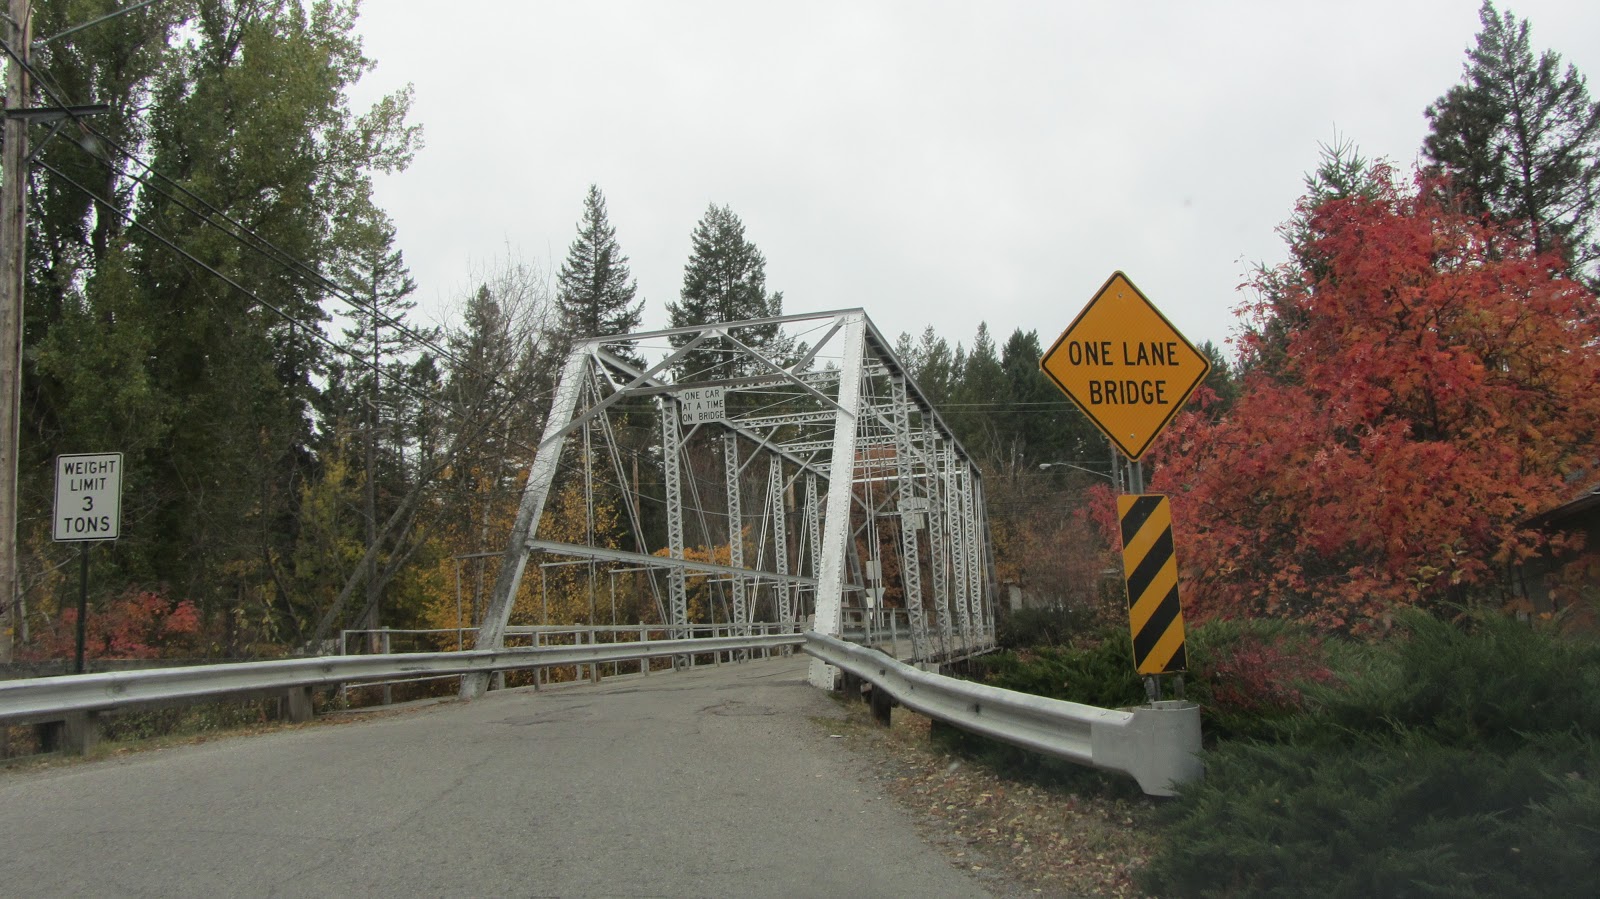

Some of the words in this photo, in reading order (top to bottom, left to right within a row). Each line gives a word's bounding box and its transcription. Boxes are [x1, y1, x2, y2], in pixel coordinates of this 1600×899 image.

[1069, 340, 1114, 366] ONE
[1122, 341, 1180, 366] LANE
[685, 391, 700, 400] ONE
[705, 389, 719, 398] CAR
[1089, 380, 1169, 405] BRIDGE
[683, 403, 691, 411] AT
[706, 400, 723, 409] TIME
[683, 414, 692, 422] ON
[699, 411, 724, 420] BRIDGE
[64, 461, 116, 474] WEIGHT
[70, 478, 106, 491] LIMIT
[82, 495, 94, 511] 3
[64, 515, 110, 533] TONS
